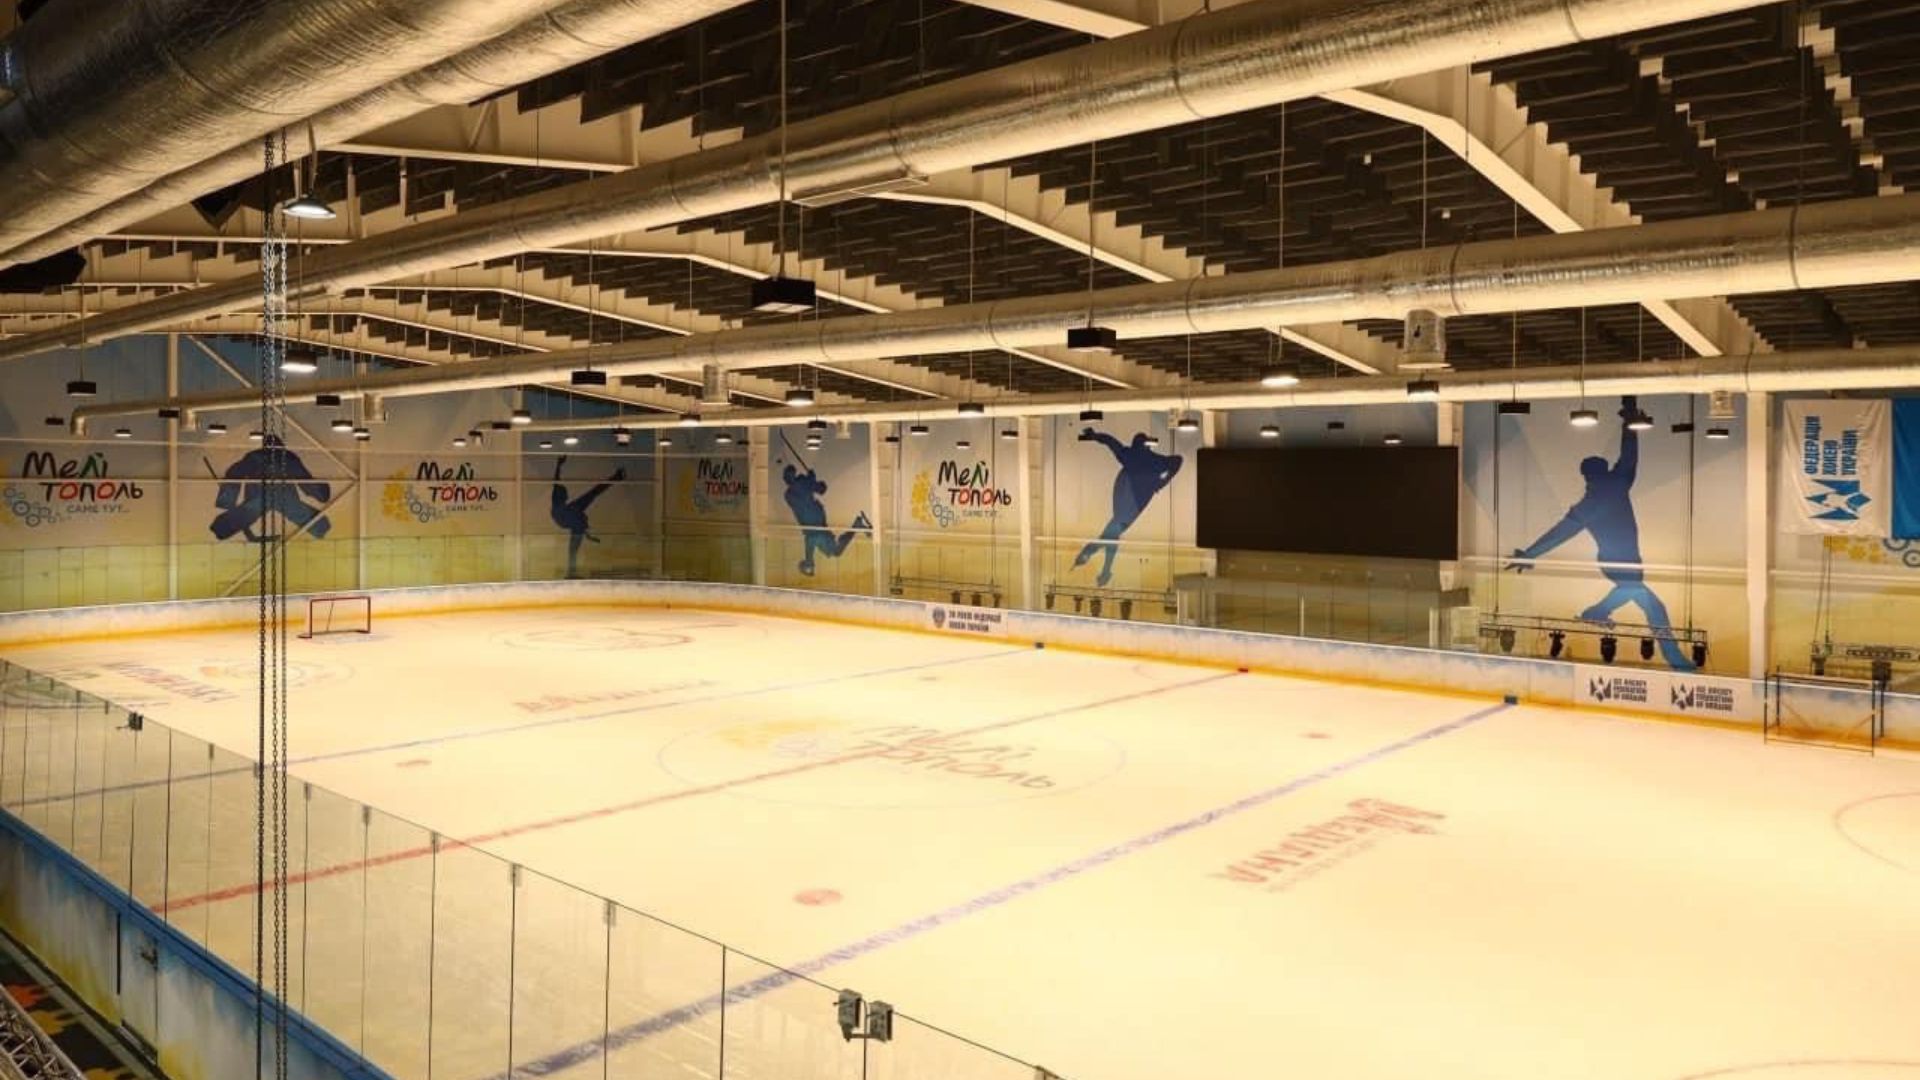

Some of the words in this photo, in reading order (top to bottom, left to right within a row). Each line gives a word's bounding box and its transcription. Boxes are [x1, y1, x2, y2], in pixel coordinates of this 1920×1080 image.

[22, 451, 108, 479] Мелі
[417, 461, 474, 481] Мелі
[938, 460, 989, 487] Мелі
